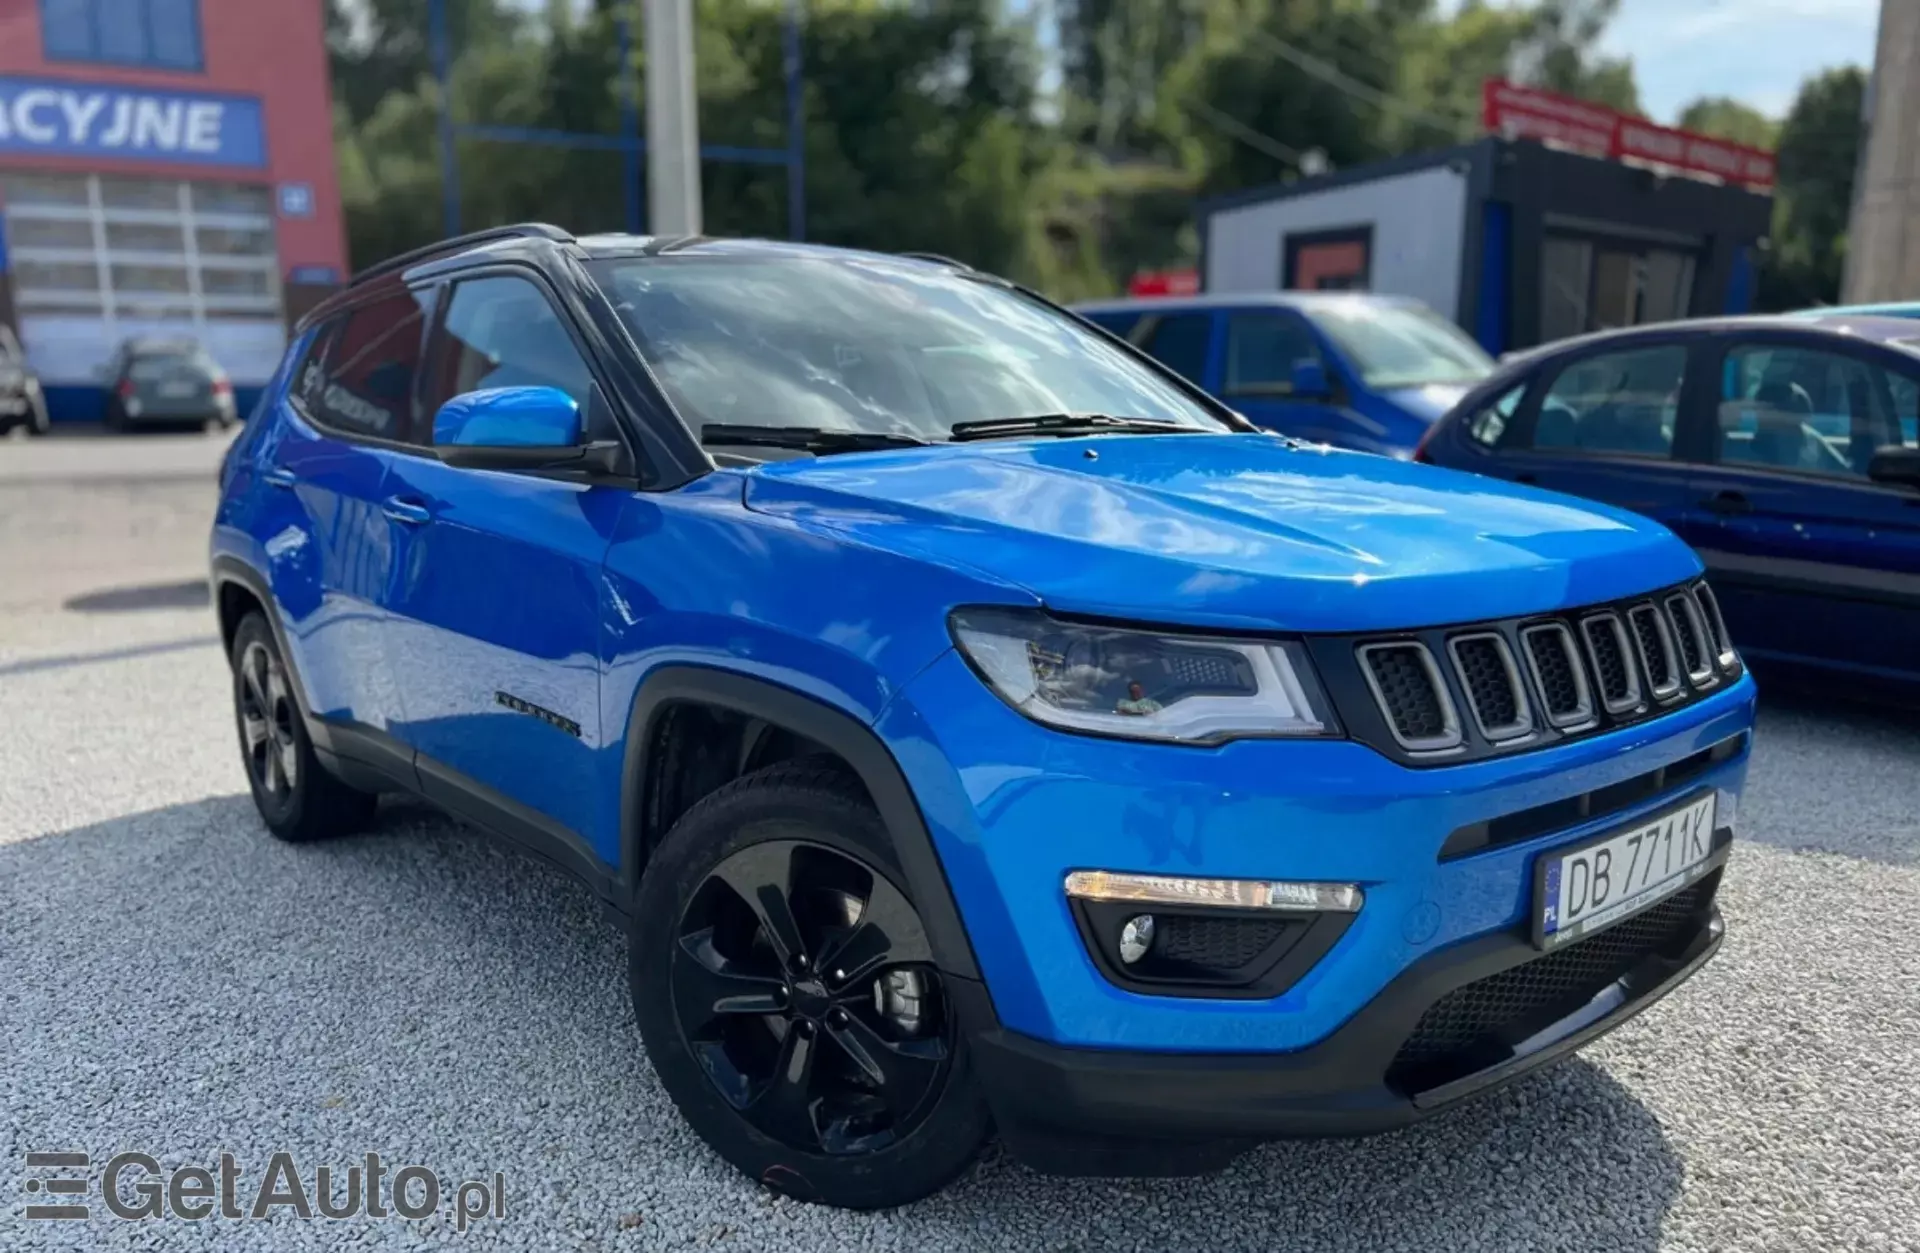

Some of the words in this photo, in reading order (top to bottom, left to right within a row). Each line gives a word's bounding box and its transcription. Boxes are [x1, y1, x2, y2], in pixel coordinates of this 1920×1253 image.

[0, 89, 223, 152] CYJNE
[1568, 848, 1612, 918] DB
[1623, 802, 1709, 894] 7711K
[1543, 908, 1556, 923] PL
